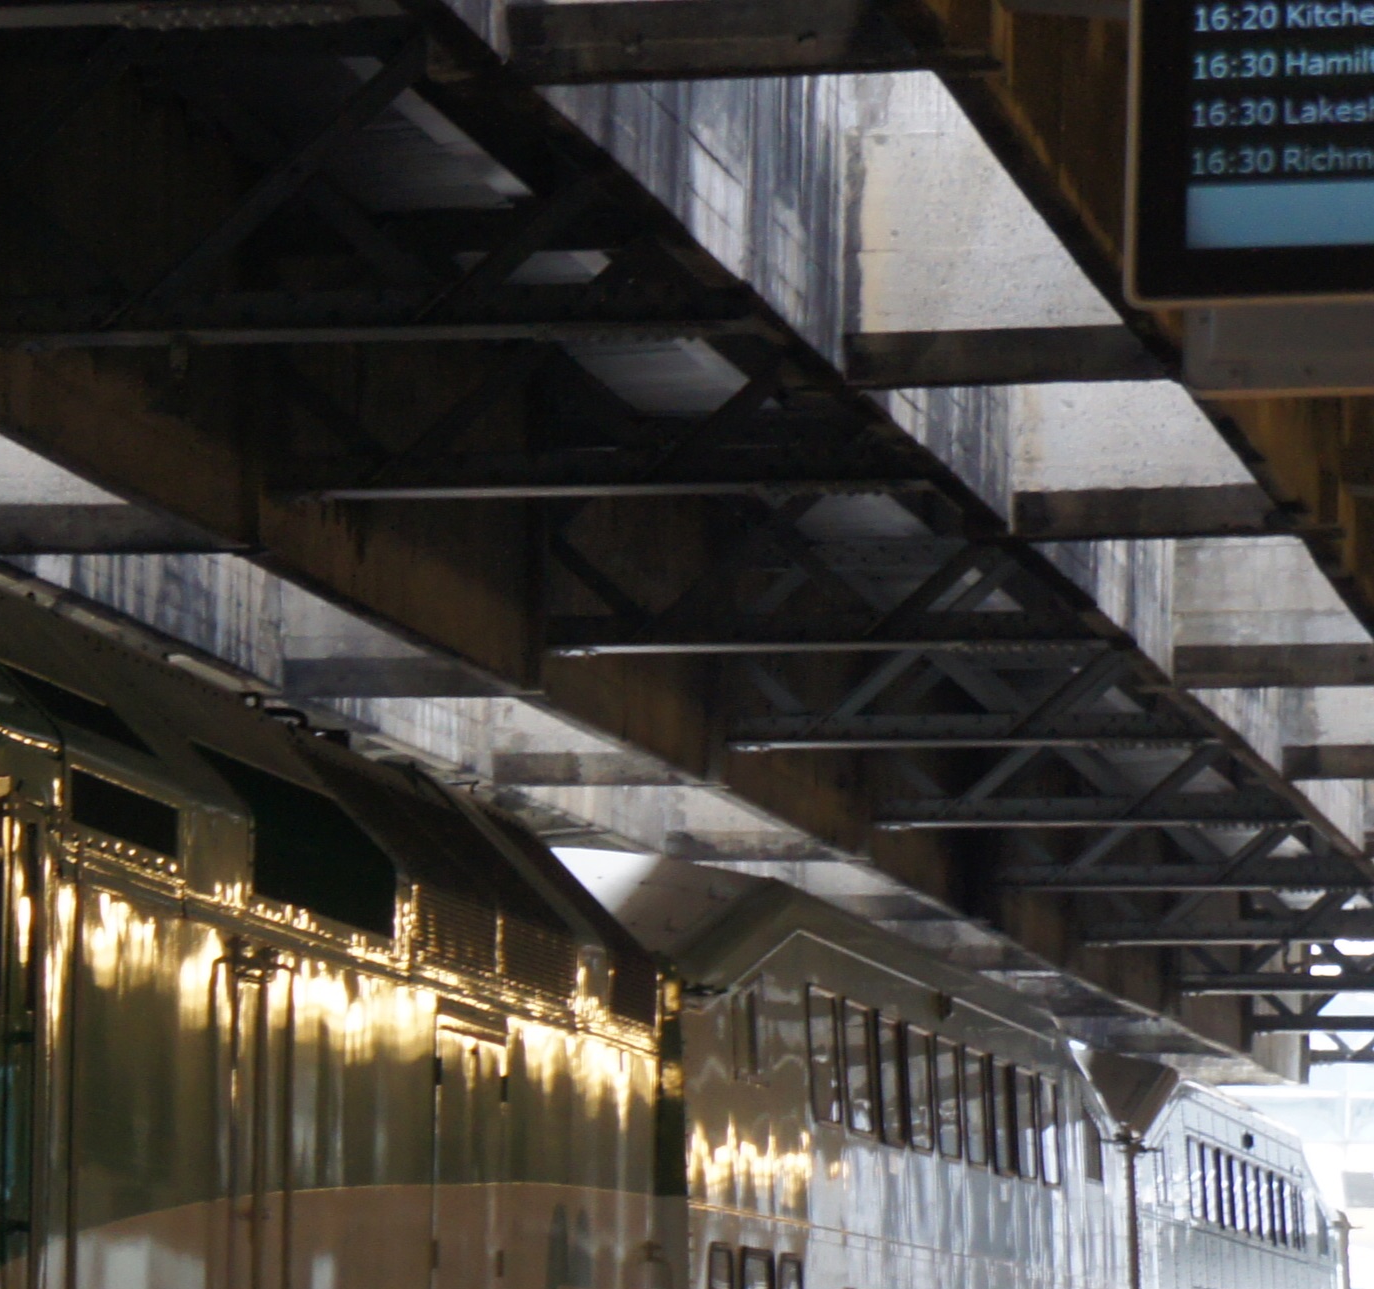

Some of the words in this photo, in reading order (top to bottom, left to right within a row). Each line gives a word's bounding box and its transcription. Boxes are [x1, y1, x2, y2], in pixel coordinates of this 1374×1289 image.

[1194, 5, 1278, 32] 16:20
[1286, 2, 1374, 28] Kitche
[1193, 52, 1278, 80] 16:30
[1193, 100, 1277, 128] 16:30
[1284, 97, 1374, 125] Lakes
[1192, 149, 1275, 175] 16:30
